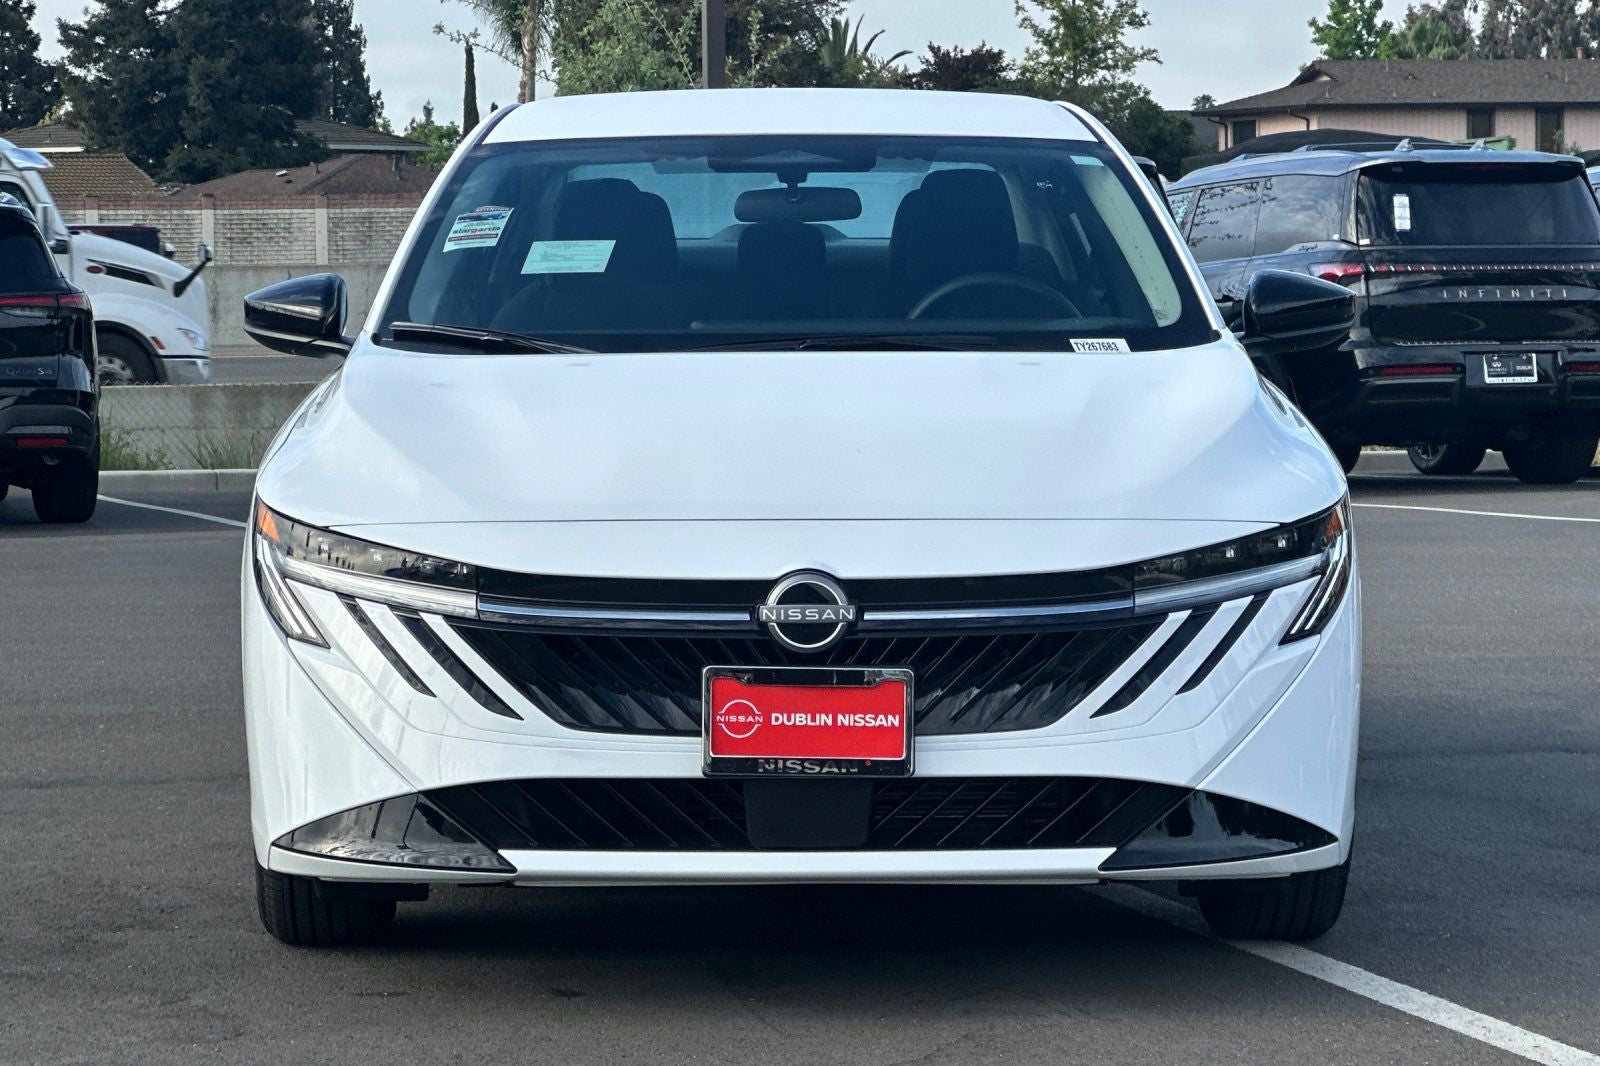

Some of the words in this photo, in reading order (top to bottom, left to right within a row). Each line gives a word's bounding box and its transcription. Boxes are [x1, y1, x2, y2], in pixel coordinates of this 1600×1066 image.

[1443, 289, 1567, 298] INFINITI
[1073, 341, 1119, 352] TY267683
[762, 608, 853, 621] NISSAN
[716, 714, 763, 723] NISSAN
[771, 713, 833, 727] DUBLIN
[837, 713, 900, 728] NISSAN
[758, 759, 858, 774] NISSAN
